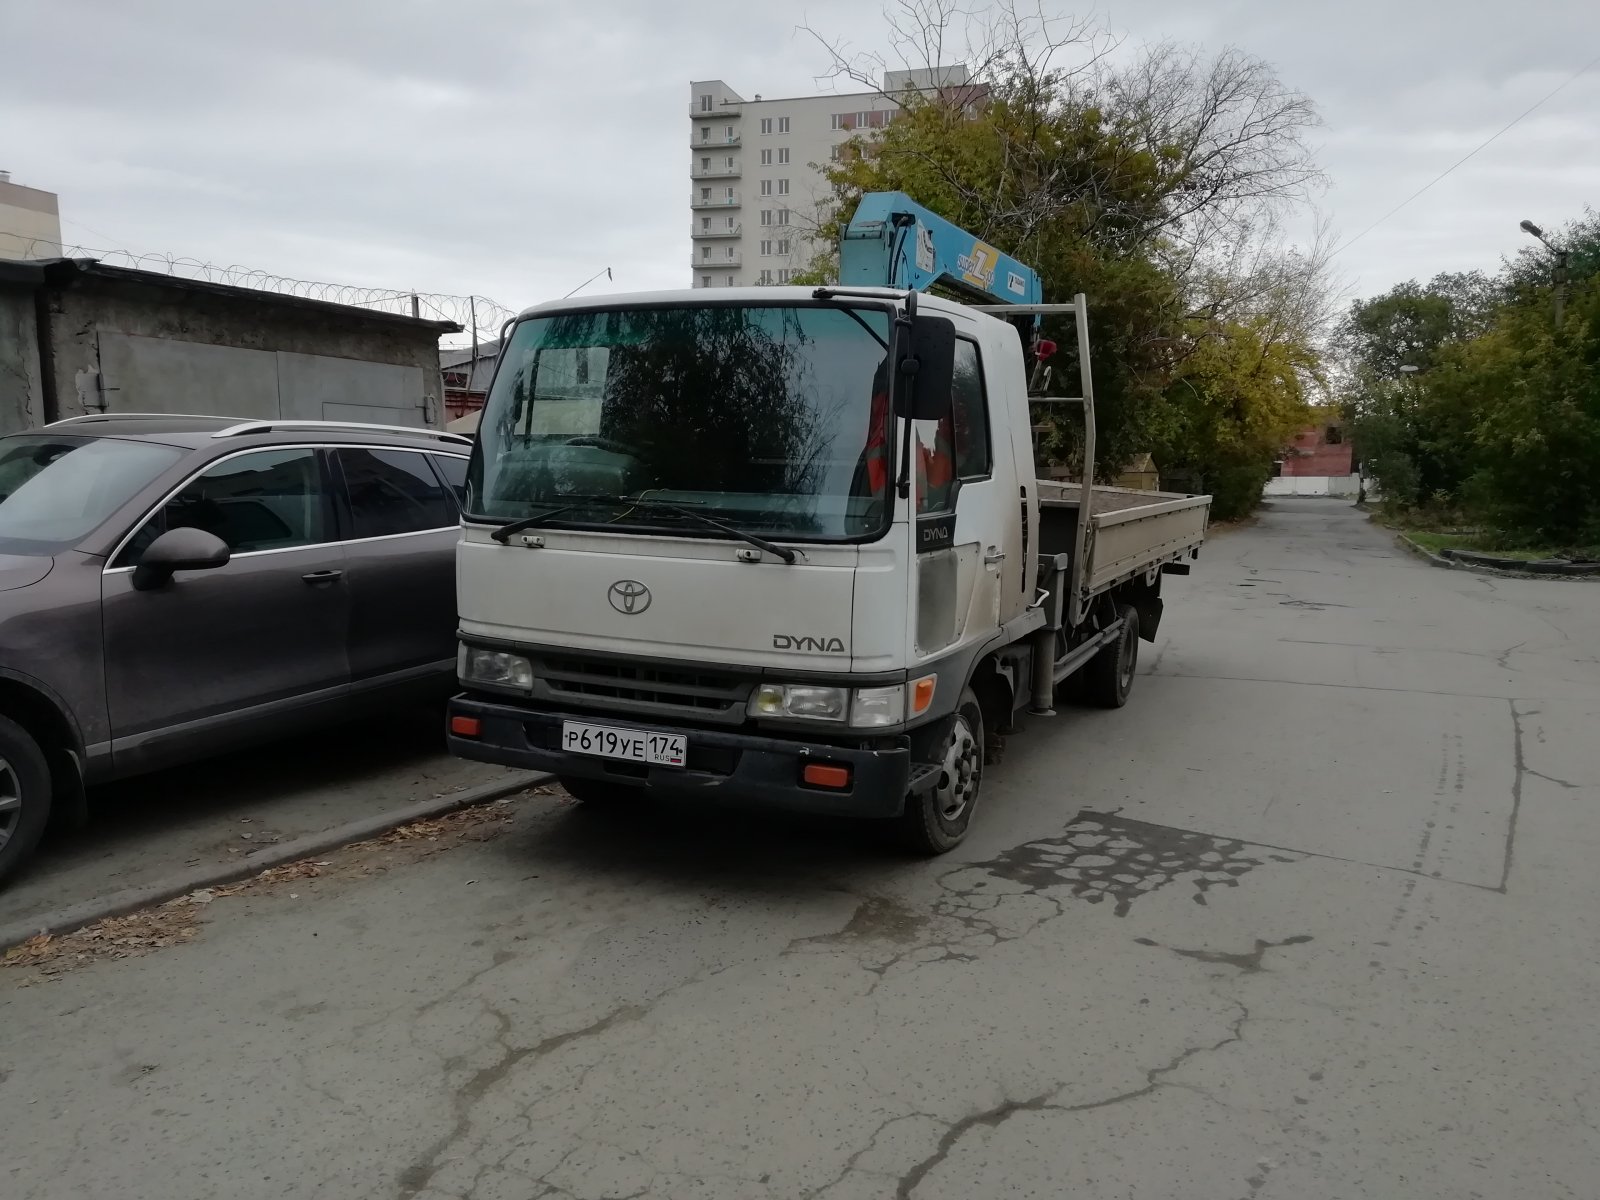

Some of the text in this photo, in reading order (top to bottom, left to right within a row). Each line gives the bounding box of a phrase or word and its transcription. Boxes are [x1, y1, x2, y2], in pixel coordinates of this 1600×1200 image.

[923, 528, 948, 541] DYNA
[773, 634, 845, 652] DYNA
[649, 737, 680, 756] 174
[654, 754, 670, 762] RUS
